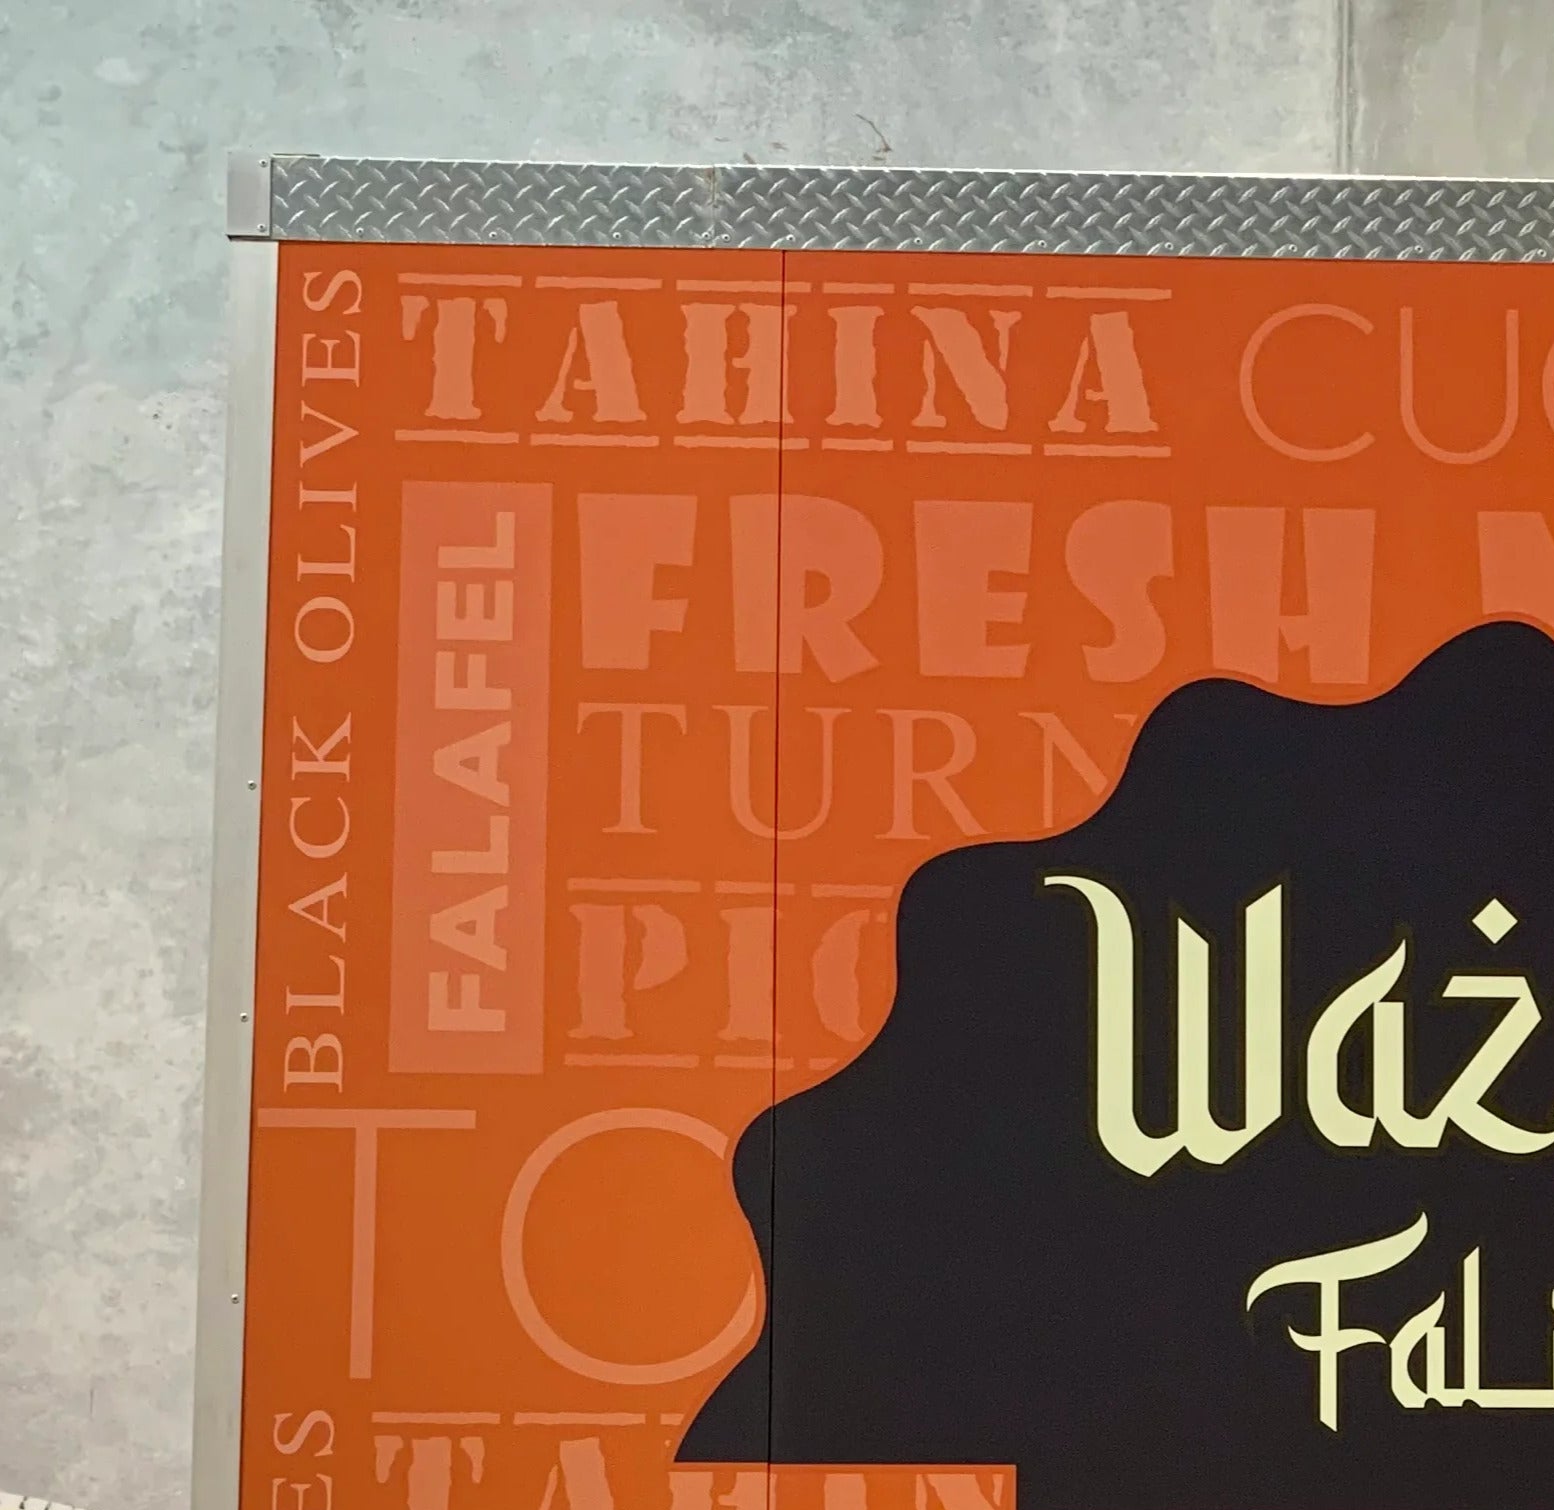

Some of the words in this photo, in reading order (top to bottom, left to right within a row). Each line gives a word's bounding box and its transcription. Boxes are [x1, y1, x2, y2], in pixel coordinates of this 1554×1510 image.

[294, 269, 362, 664] OLIVES
[401, 297, 1159, 433] TAHINA
[427, 511, 516, 1032] FALAFEL
[577, 493, 1376, 685] FRESH
[283, 712, 353, 1093] BLACK
